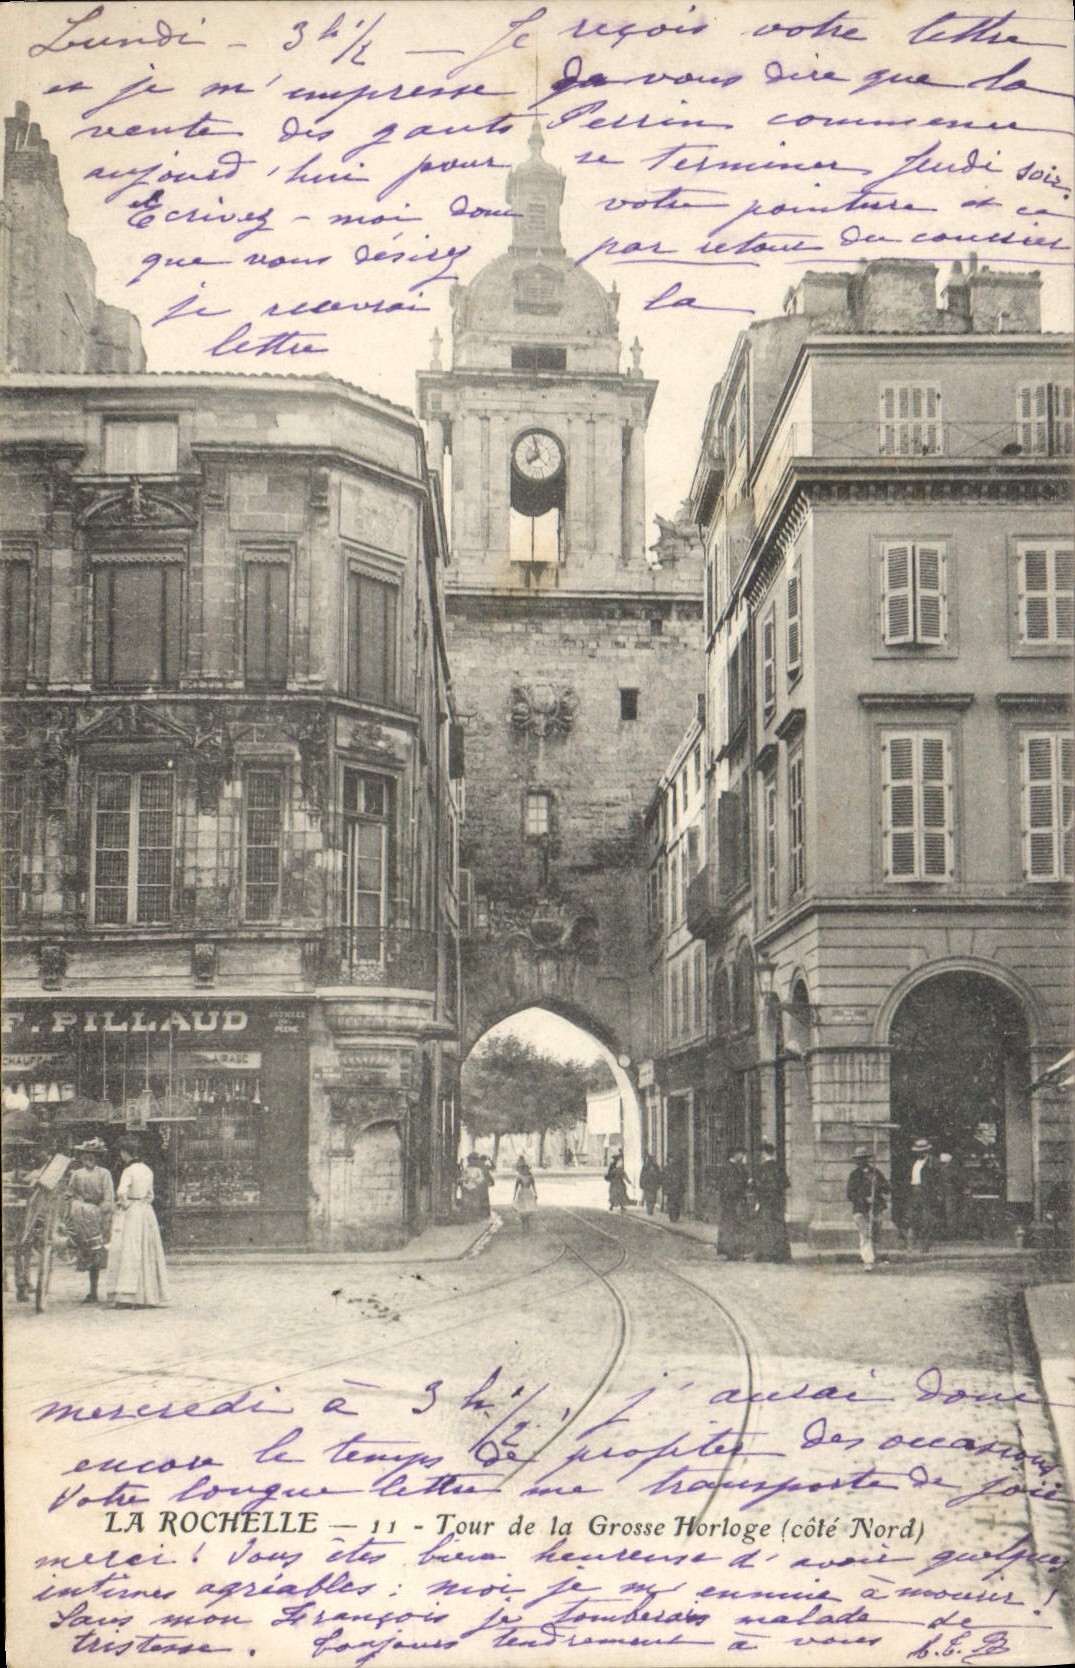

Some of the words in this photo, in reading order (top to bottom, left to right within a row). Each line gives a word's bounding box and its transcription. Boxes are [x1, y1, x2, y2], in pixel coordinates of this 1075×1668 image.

[28, 5, 206, 57] Lundi
[557, 4, 709, 49] reçois
[742, 10, 868, 42] votre
[908, 10, 1067, 49] lettre
[625, 72, 745, 90] vous
[765, 53, 851, 84] dire
[849, 69, 966, 97] que
[966, 57, 1075, 100] la
[70, 112, 244, 140] vente
[278, 117, 336, 144] des
[342, 112, 549, 163] gants
[376, 152, 511, 201] pour
[450, 195, 524, 217] donc
[598, 187, 730, 211] votre
[708, 182, 936, 236] pointure
[126, 252, 233, 287] que
[244, 253, 330, 268] vous
[354, 231, 471, 292] désirez
[575, 237, 675, 267] par
[697, 233, 824, 256] retour
[840, 225, 900, 246] du
[642, 281, 755, 315] la
[206, 322, 329, 357] lettre
[51, 1009, 249, 1032] PILLAUD
[254, 1425, 304, 1464] le
[323, 1432, 443, 1483] temps
[801, 1417, 864, 1451] des
[170, 1475, 352, 1514] longue
[372, 1472, 504, 1499] lettre
[519, 1484, 603, 1498] me
[427, 1572, 526, 1597] moi
[150, 1610, 253, 1627] mon
[735, 1603, 925, 1627] malade
[927, 1610, 1052, 1630] de
[795, 1633, 883, 1648] vous
